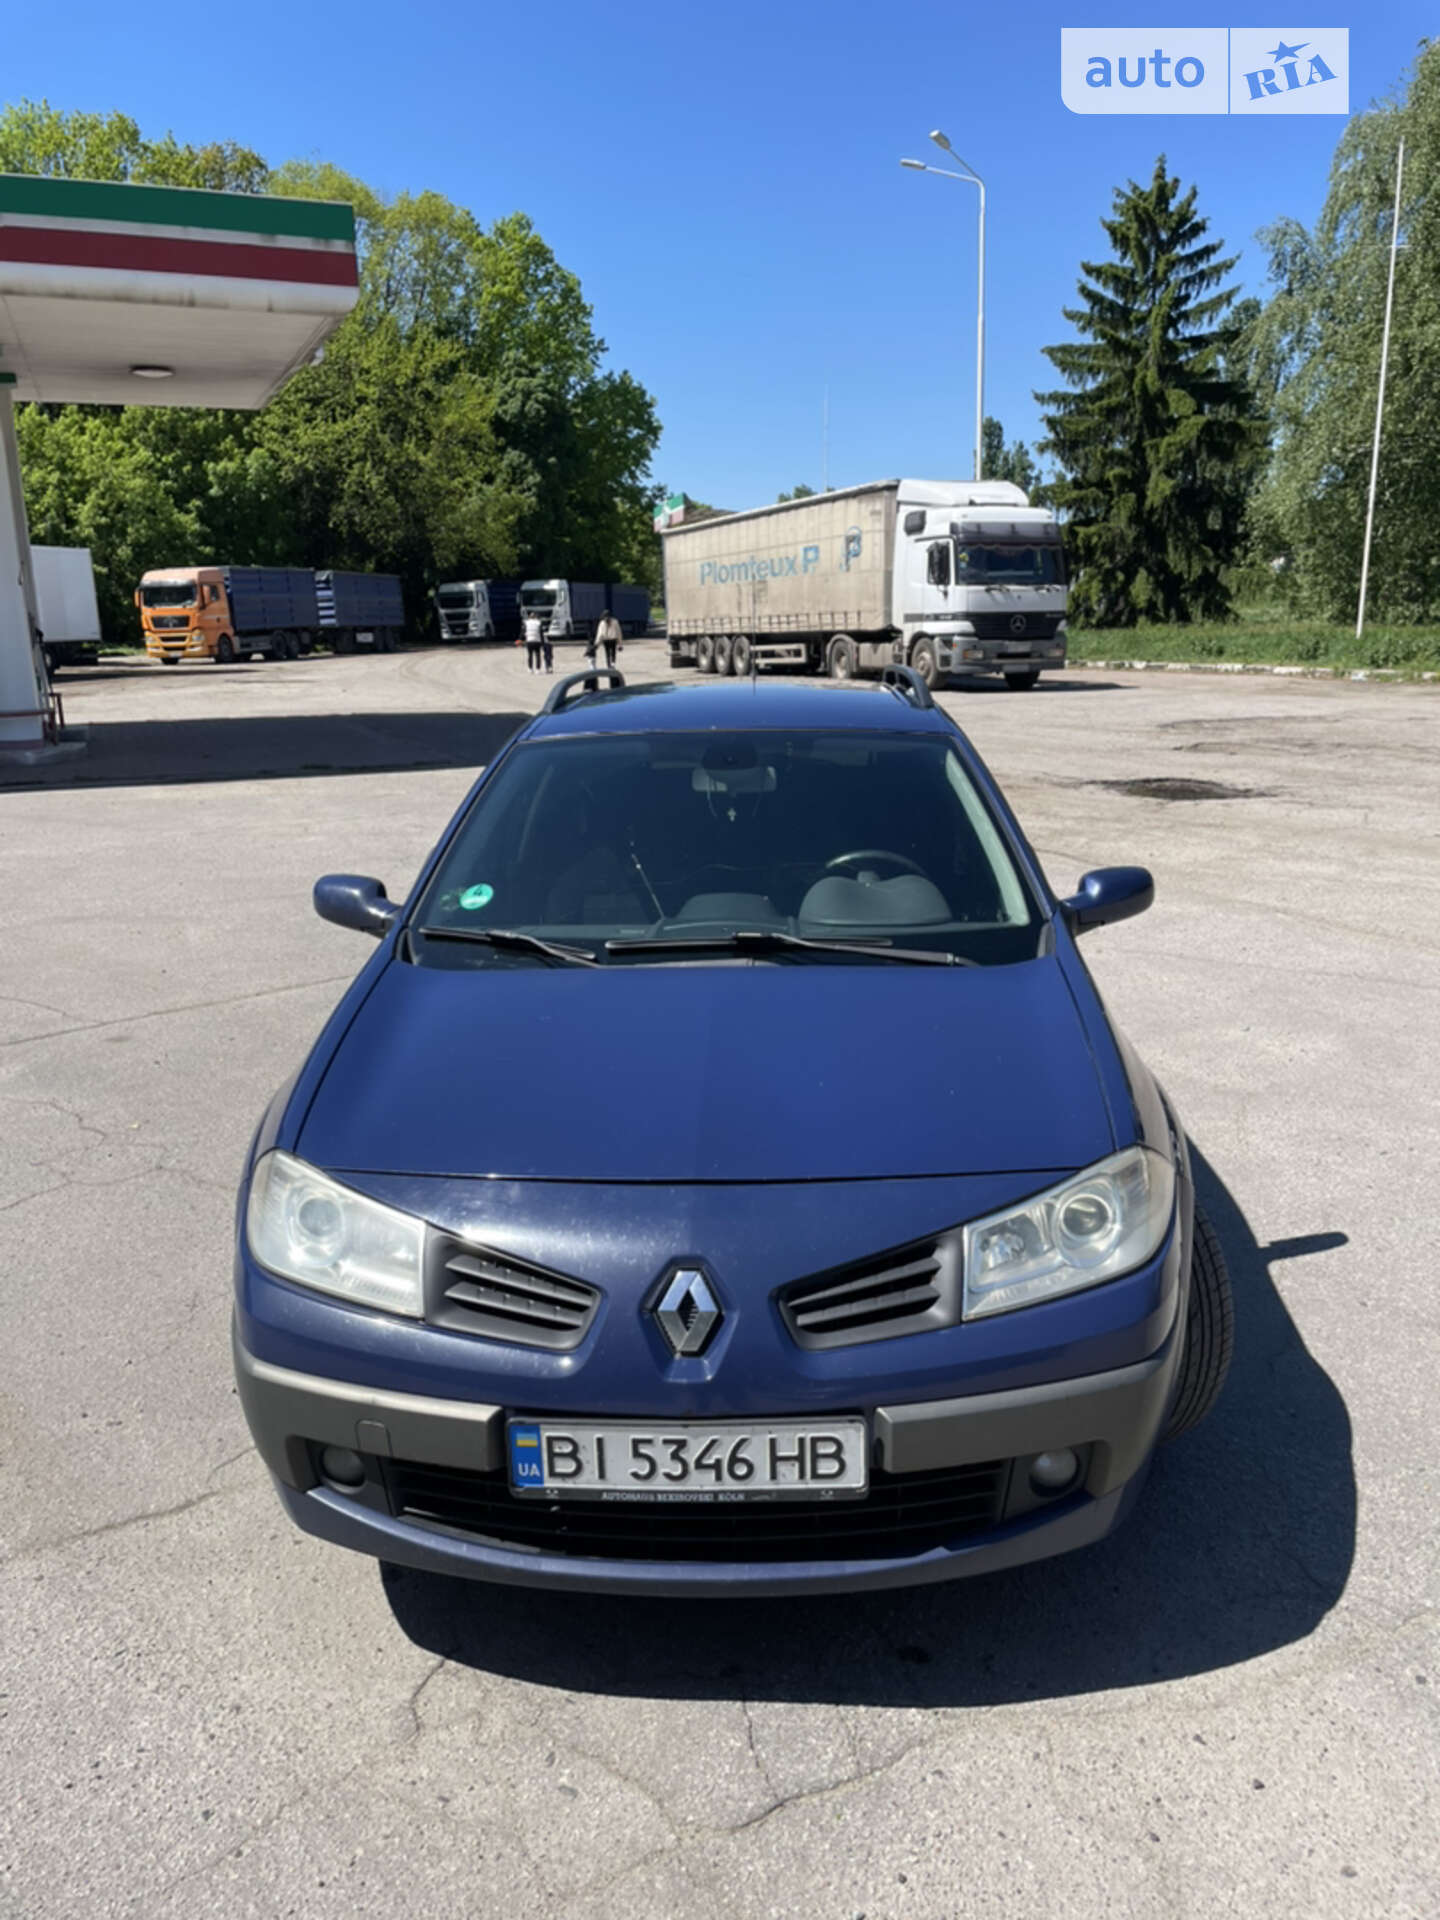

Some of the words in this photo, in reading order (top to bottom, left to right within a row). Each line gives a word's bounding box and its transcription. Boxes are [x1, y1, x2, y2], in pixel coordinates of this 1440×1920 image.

[700, 556, 797, 585] Plomteux
[518, 1463, 541, 1478] UA
[546, 1435, 606, 1480] BI
[630, 1437, 754, 1482] 5346
[769, 1435, 847, 1481] HB
